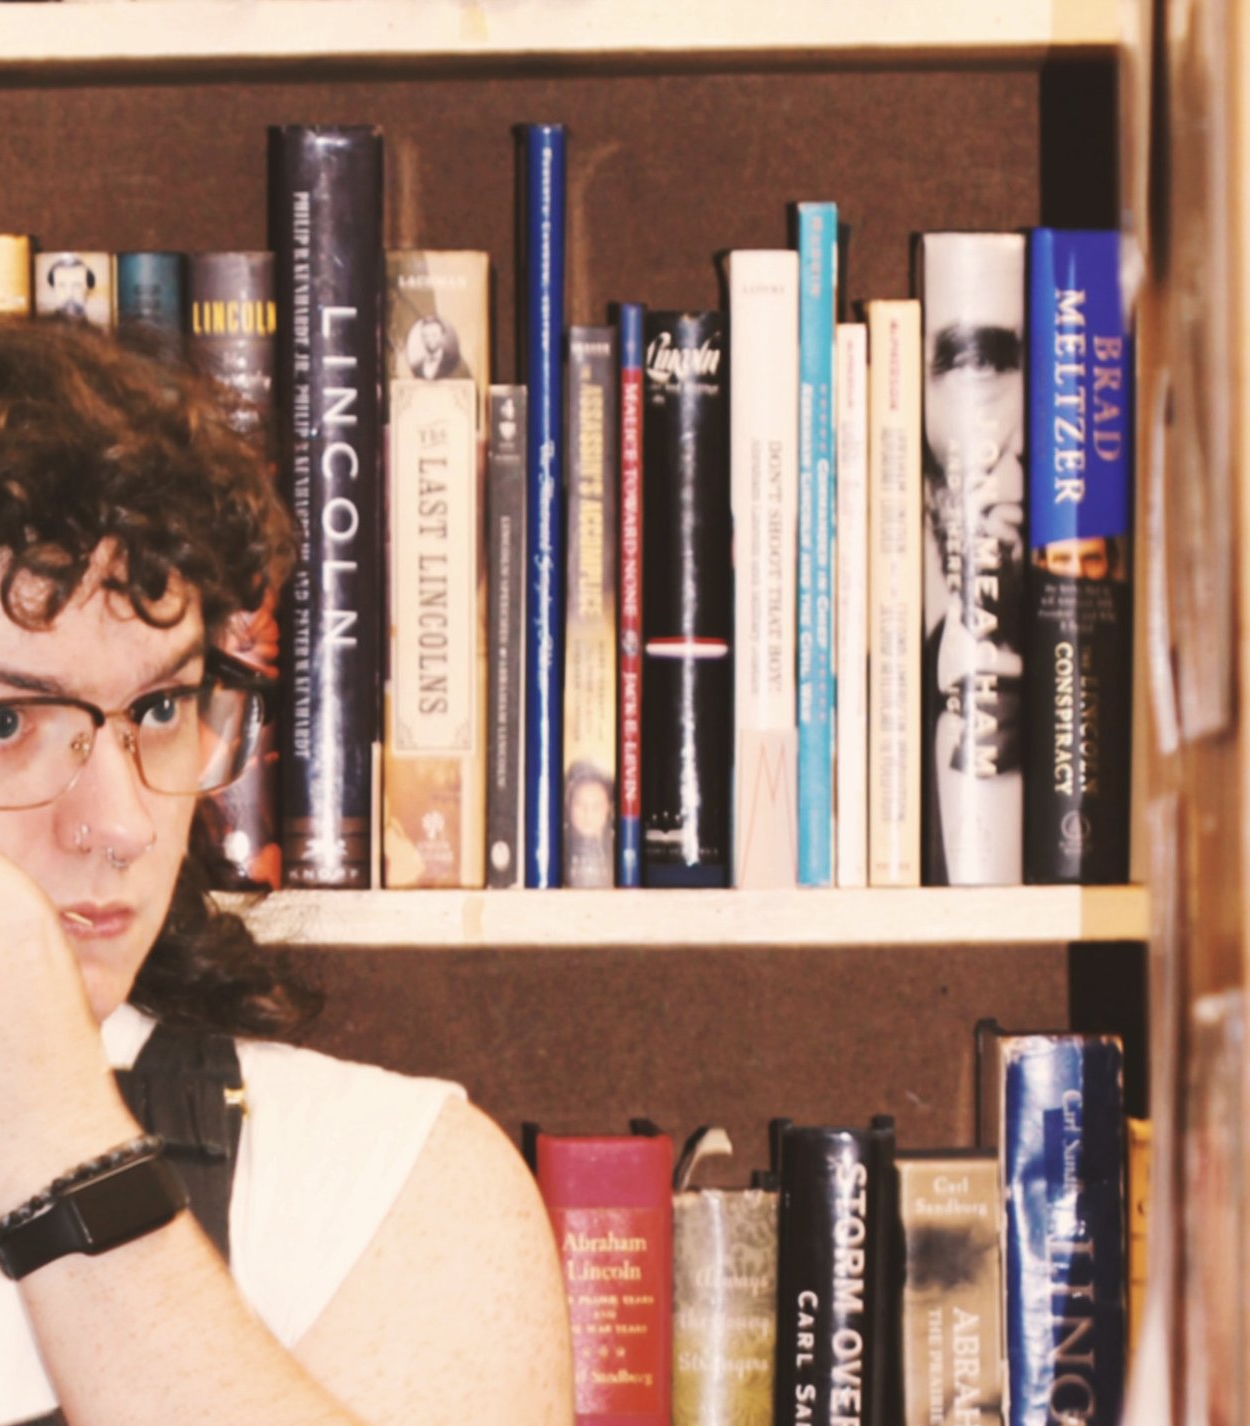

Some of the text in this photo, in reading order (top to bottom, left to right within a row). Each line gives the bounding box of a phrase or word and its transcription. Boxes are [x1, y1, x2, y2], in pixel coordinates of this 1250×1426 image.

[293, 191, 310, 246] PHILIP
[1053, 288, 1087, 505] MELTZER
[1092, 335, 1122, 463] BRAD
[578, 382, 605, 496] ASSASSIN'S
[767, 439, 784, 503] DON'T
[322, 305, 359, 648] LINCOLN
[621, 383, 640, 618] MALICE TOWARD NONE
[498, 515, 511, 579] LINCOLN
[578, 499, 604, 617] ACCOMPLICE
[767, 509, 784, 584] SHOOT
[418, 456, 449, 715] LAST LINCOLNS
[767, 587, 784, 641] THAT
[973, 536, 1000, 776] MEACHAM
[495, 661, 509, 789] ABRAHAM LINCOLN
[623, 672, 639, 715] JACK
[1054, 642, 1075, 797] CONSPIRACY
[623, 740, 638, 801] LEVIN
[1061, 1089, 1084, 1132] Carl
[914, 1199, 989, 1218] Sandburg
[933, 1176, 970, 1195] Carl
[563, 1231, 648, 1252] Abraham
[567, 1260, 641, 1281] Lincoln
[832, 1163, 867, 1315] STORM
[795, 1290, 819, 1369] CARL
[927, 1307, 943, 1348] THE
[928, 1353, 944, 1425] PRAIRIE
